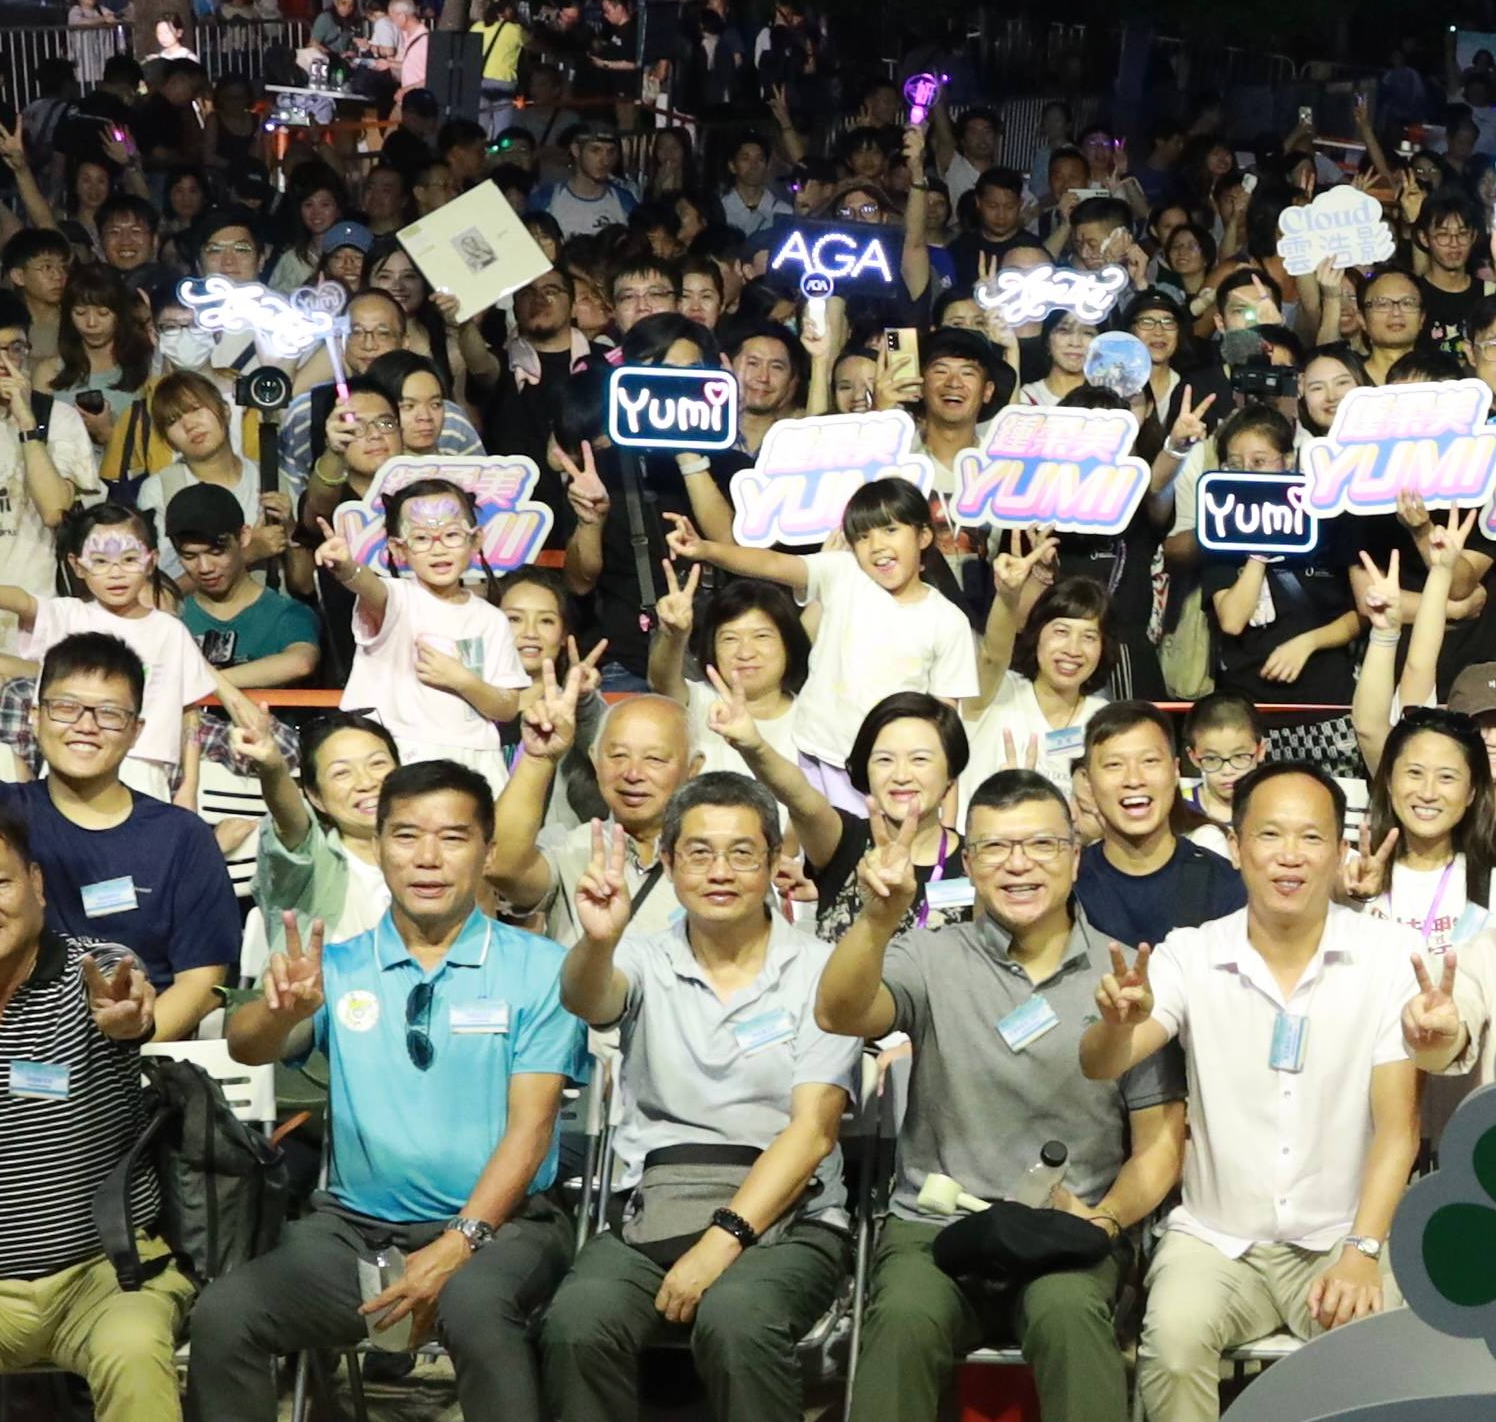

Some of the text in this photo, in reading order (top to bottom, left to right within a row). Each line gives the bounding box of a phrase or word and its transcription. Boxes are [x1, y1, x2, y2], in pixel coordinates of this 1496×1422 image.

[1279, 199, 1373, 233] Cloud
[771, 230, 893, 283] AGA
[1278, 223, 1393, 271] 雲浩影
[617, 381, 730, 434] Yumi
[957, 453, 1142, 524] YUMI
[1204, 485, 1308, 538] Yumi
